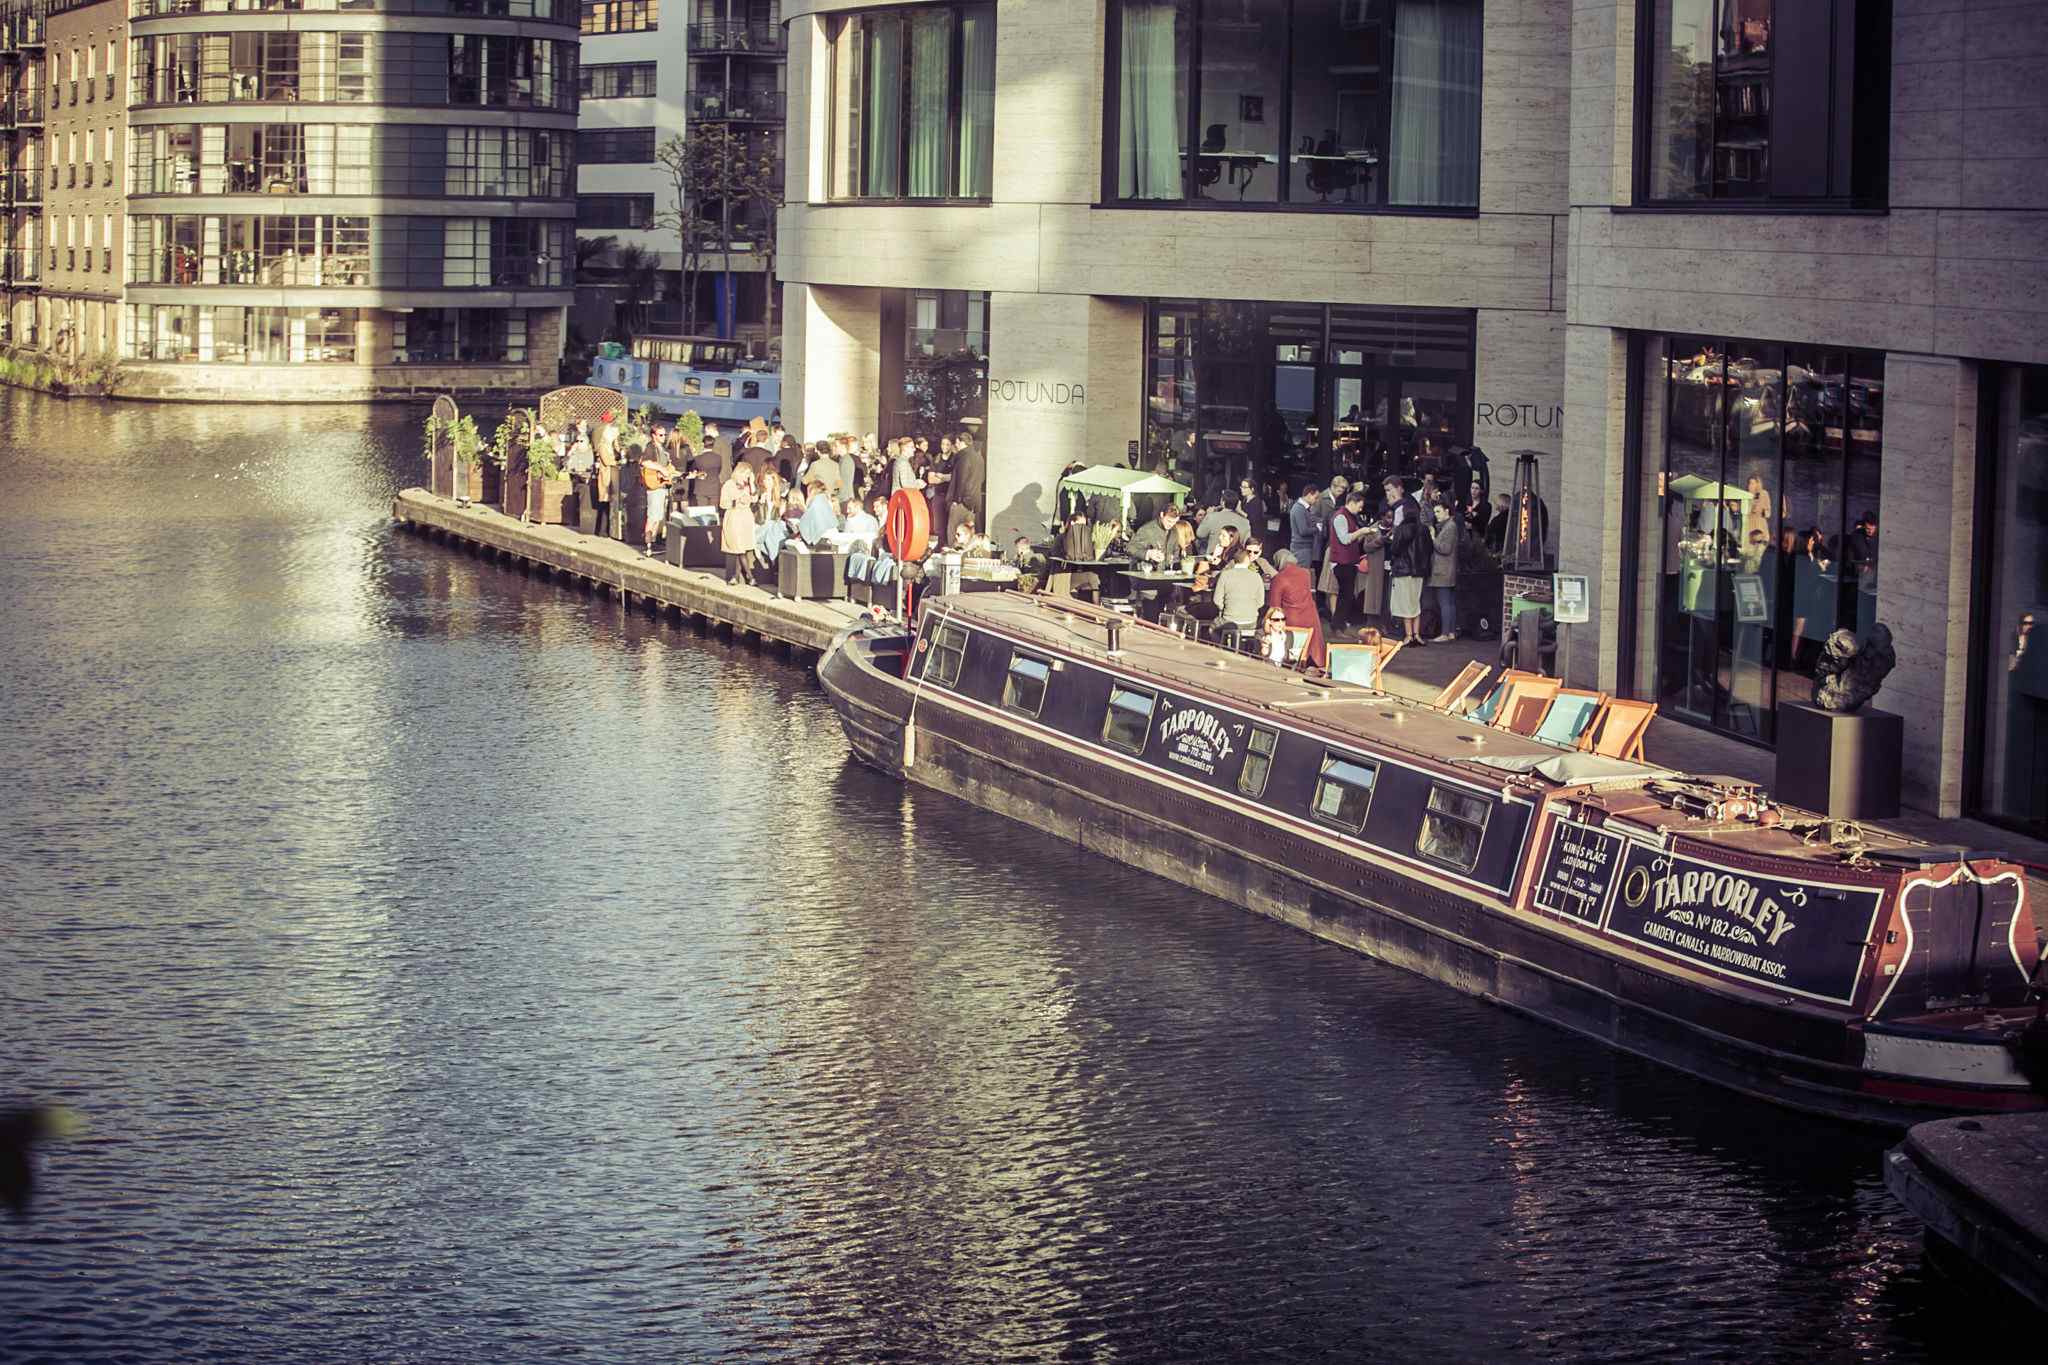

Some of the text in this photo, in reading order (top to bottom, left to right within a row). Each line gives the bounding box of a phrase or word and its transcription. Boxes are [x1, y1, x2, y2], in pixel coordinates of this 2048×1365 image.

[989, 379, 1085, 405] ROTUNDA
[1160, 709, 1234, 760] TARPORLEY
[1586, 848, 1607, 865] PLACE
[1652, 871, 1795, 946] TARPORLEY
[1643, 921, 1678, 943] CAMDEN
[1675, 932, 1705, 954] CANALS
[1710, 943, 1763, 972] NARROWBOAT
